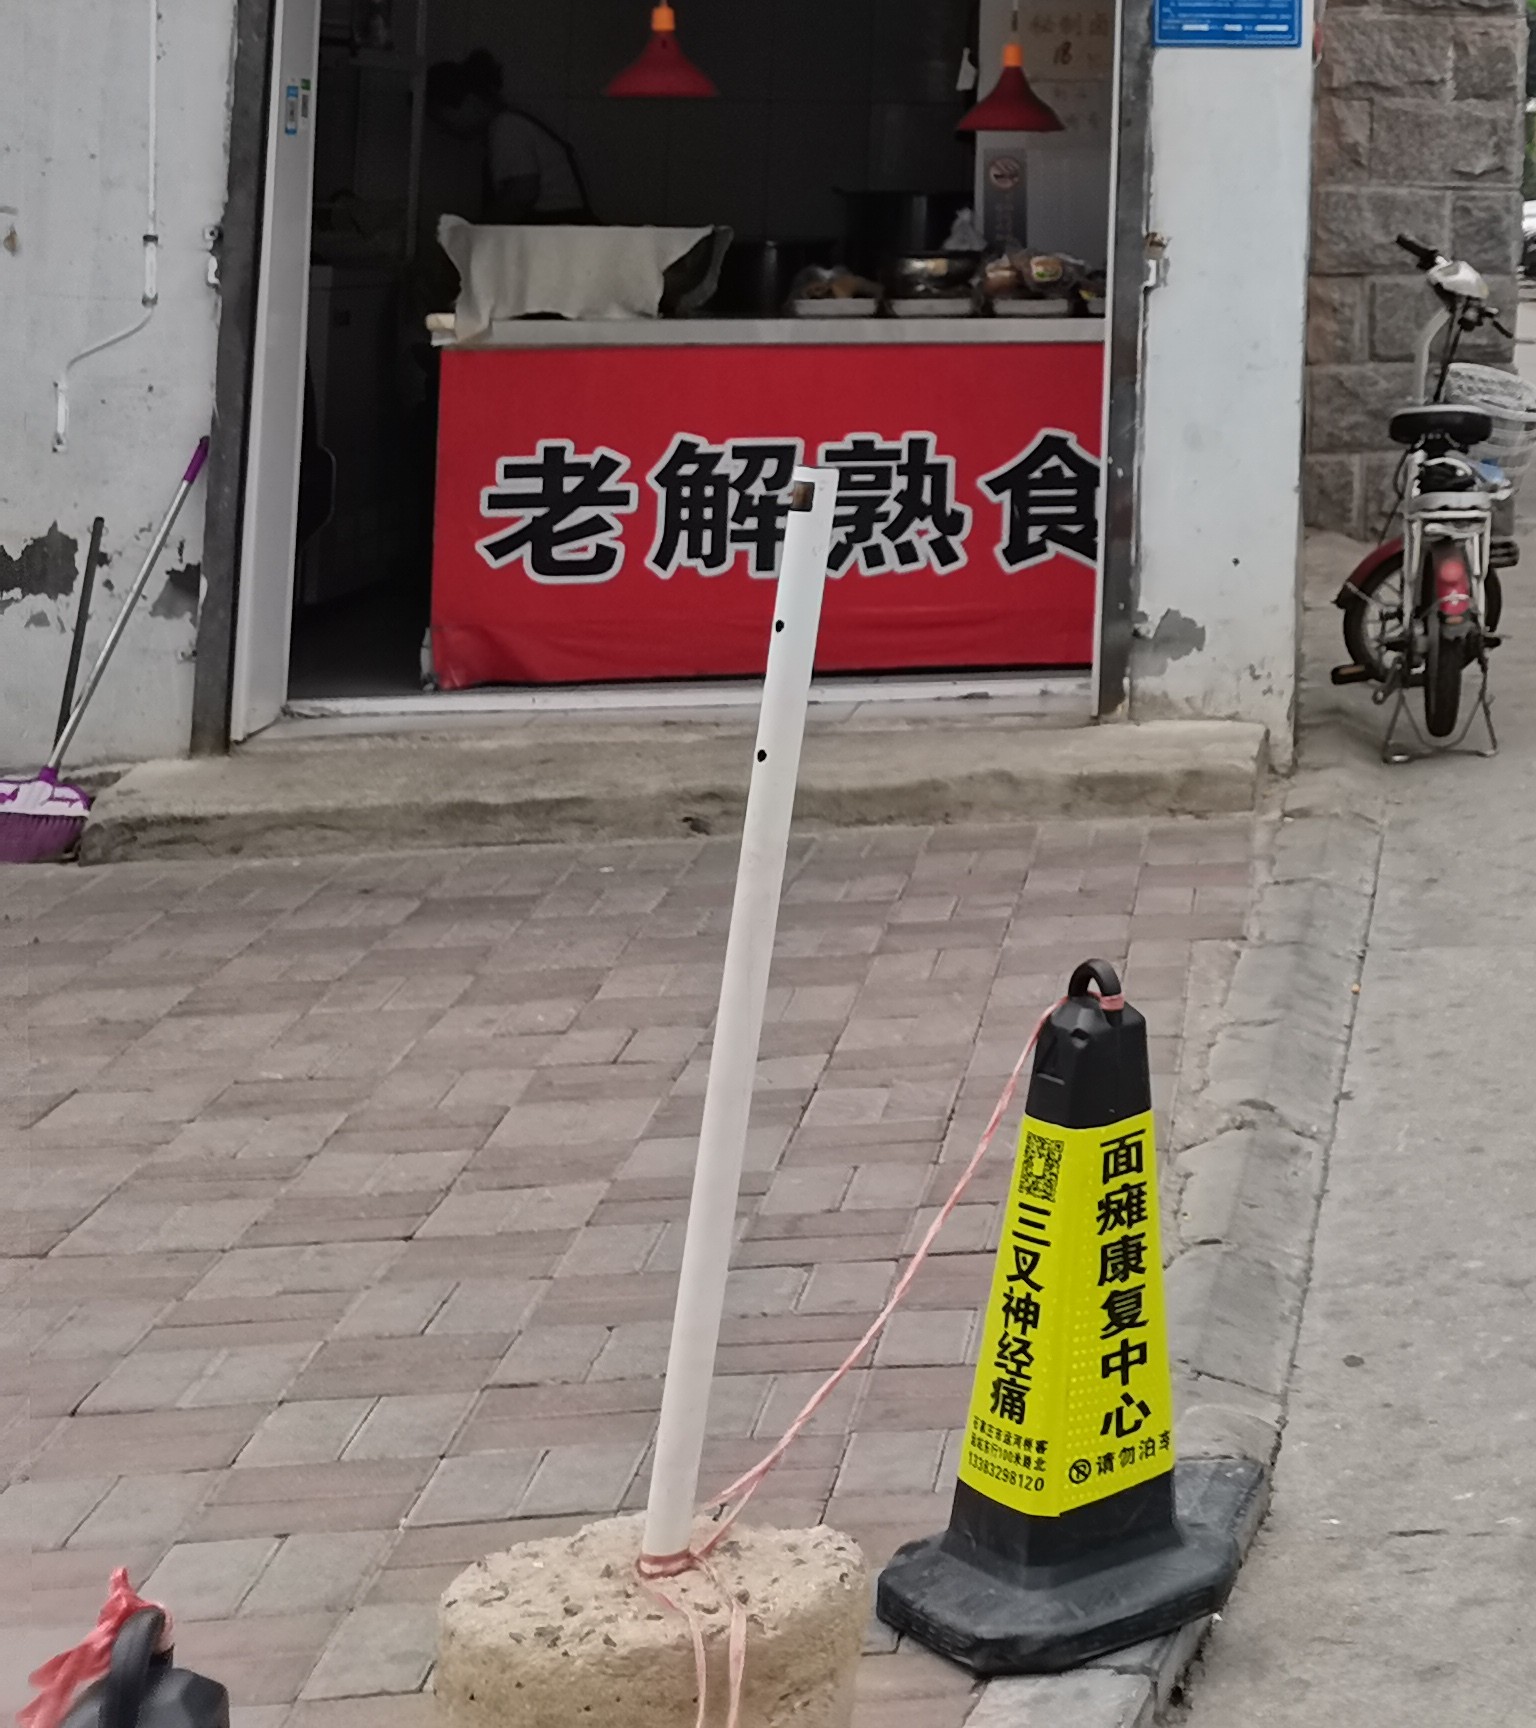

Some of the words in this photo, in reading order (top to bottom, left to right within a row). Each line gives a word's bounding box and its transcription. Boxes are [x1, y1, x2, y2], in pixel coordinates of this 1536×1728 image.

[476, 428, 1101, 584] 老解熟食
[989, 1200, 1053, 1426] 三叉神经痛
[1096, 1127, 1151, 1440] 面瘫康复中心
[1096, 1429, 1172, 1476] 请勿泊车
